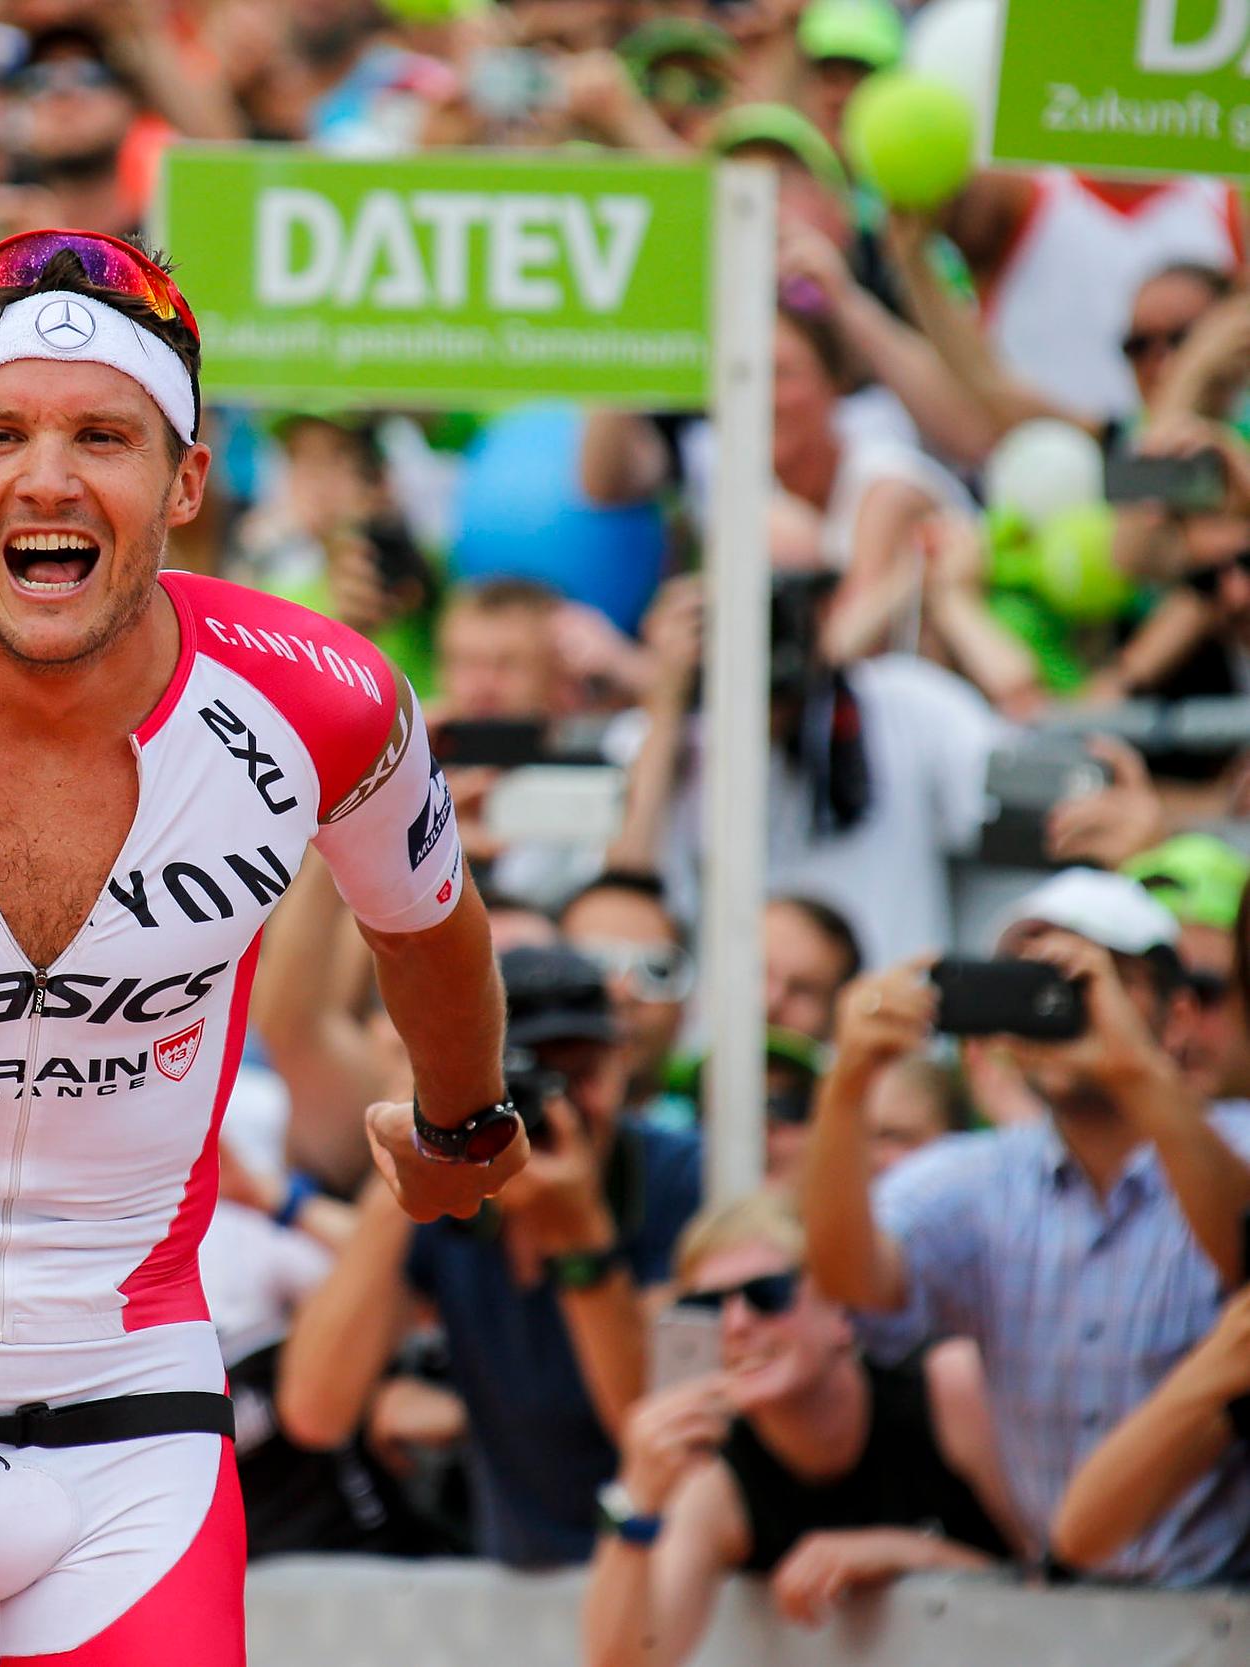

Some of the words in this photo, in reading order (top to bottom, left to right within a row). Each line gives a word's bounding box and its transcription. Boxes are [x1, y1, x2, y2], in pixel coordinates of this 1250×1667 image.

[1042, 81, 1222, 140] Zukunft
[260, 186, 654, 312] DATEV
[205, 617, 382, 705] CANYON
[198, 698, 298, 815] 2XU
[329, 707, 408, 823] 2XU
[168, 1048, 187, 1063] 13
